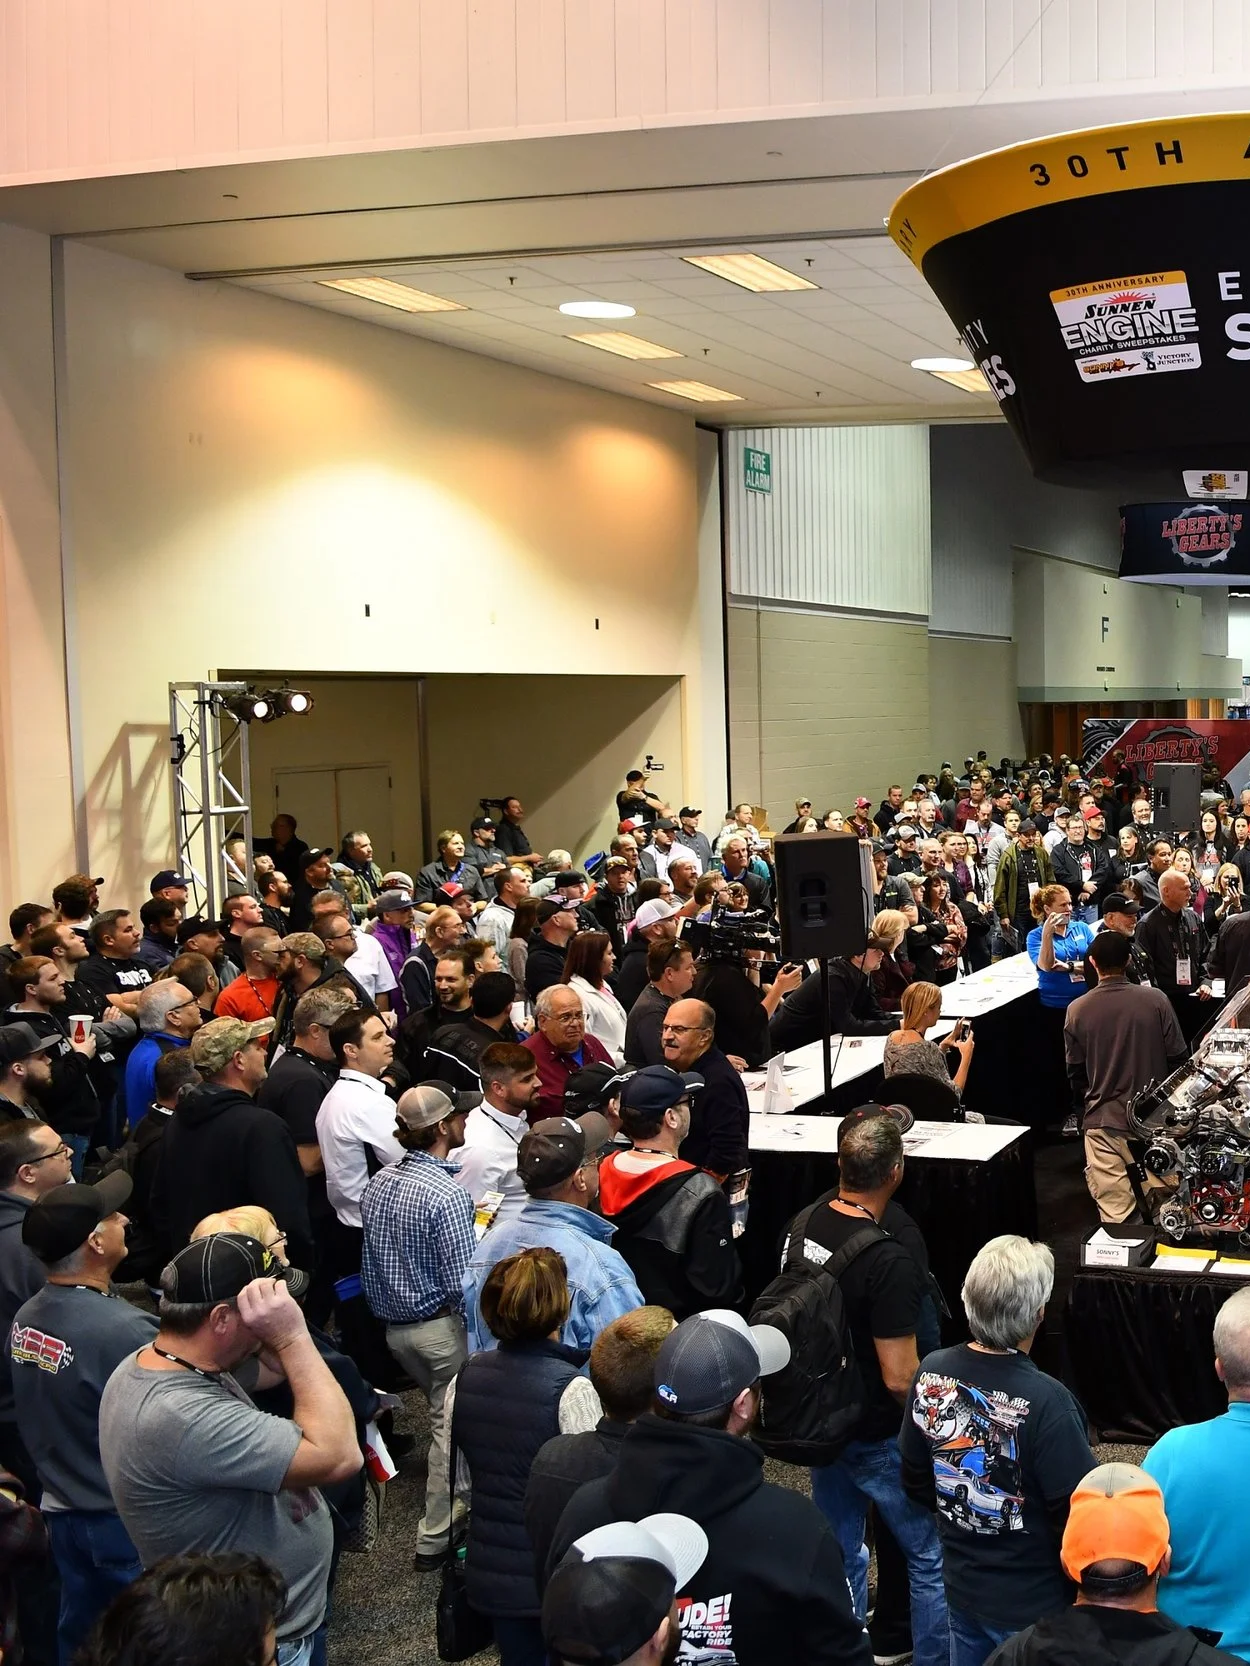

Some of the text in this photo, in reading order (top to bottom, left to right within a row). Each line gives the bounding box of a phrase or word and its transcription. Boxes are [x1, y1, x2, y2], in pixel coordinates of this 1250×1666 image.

[1029, 140, 1184, 187] 30TH
[1065, 274, 1166, 298] 30TH ANNIVERSARY
[1060, 308, 1200, 350] ENGINE
[1079, 334, 1187, 356] CHARITY SWEEPSTAKES
[1156, 357, 1195, 366] JUNCTION
[1157, 352, 1192, 361] VICTORY
[749, 451, 767, 472] FIRE
[745, 469, 771, 492] ALARM
[1161, 513, 1243, 538] LIBERTY'S
[1178, 531, 1232, 553] GEARS
[1125, 735, 1219, 763] LIBERTY'S
[682, 1629, 732, 1639] FACTORY
[706, 1638, 733, 1646] RIDE
